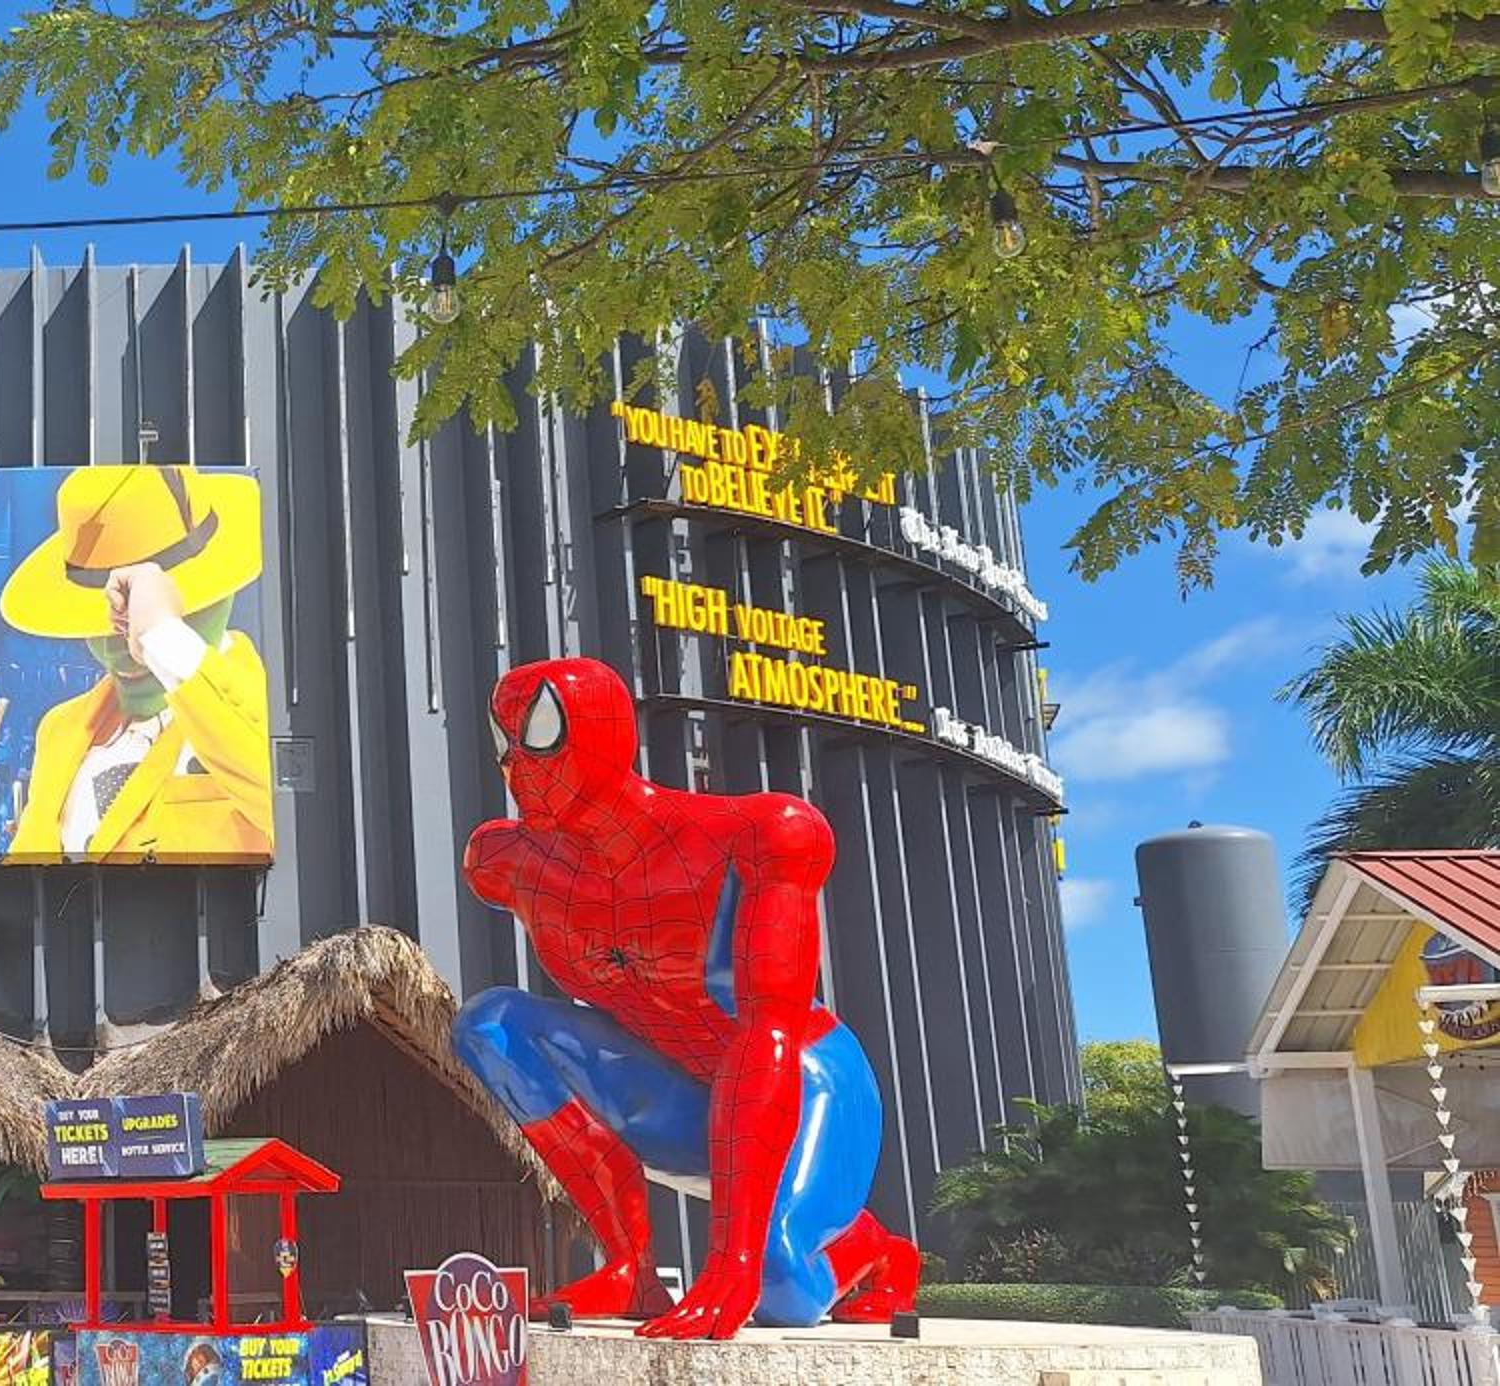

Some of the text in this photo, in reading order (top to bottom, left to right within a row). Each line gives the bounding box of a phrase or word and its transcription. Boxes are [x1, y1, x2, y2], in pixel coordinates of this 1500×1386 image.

[667, 417, 719, 461] HAVE
[719, 429, 747, 465] TO
[680, 464, 706, 503] TO
[734, 604, 827, 655] VOLTAGE
[78, 1109, 99, 1121] YOUR
[121, 1113, 179, 1132] UPGRADES
[53, 1123, 109, 1142] TICKETS
[61, 1145, 104, 1166] HERE!
[239, 1338, 266, 1357] BUY
[427, 1308, 525, 1386] BONGO
[241, 1357, 292, 1380] TICKETS
